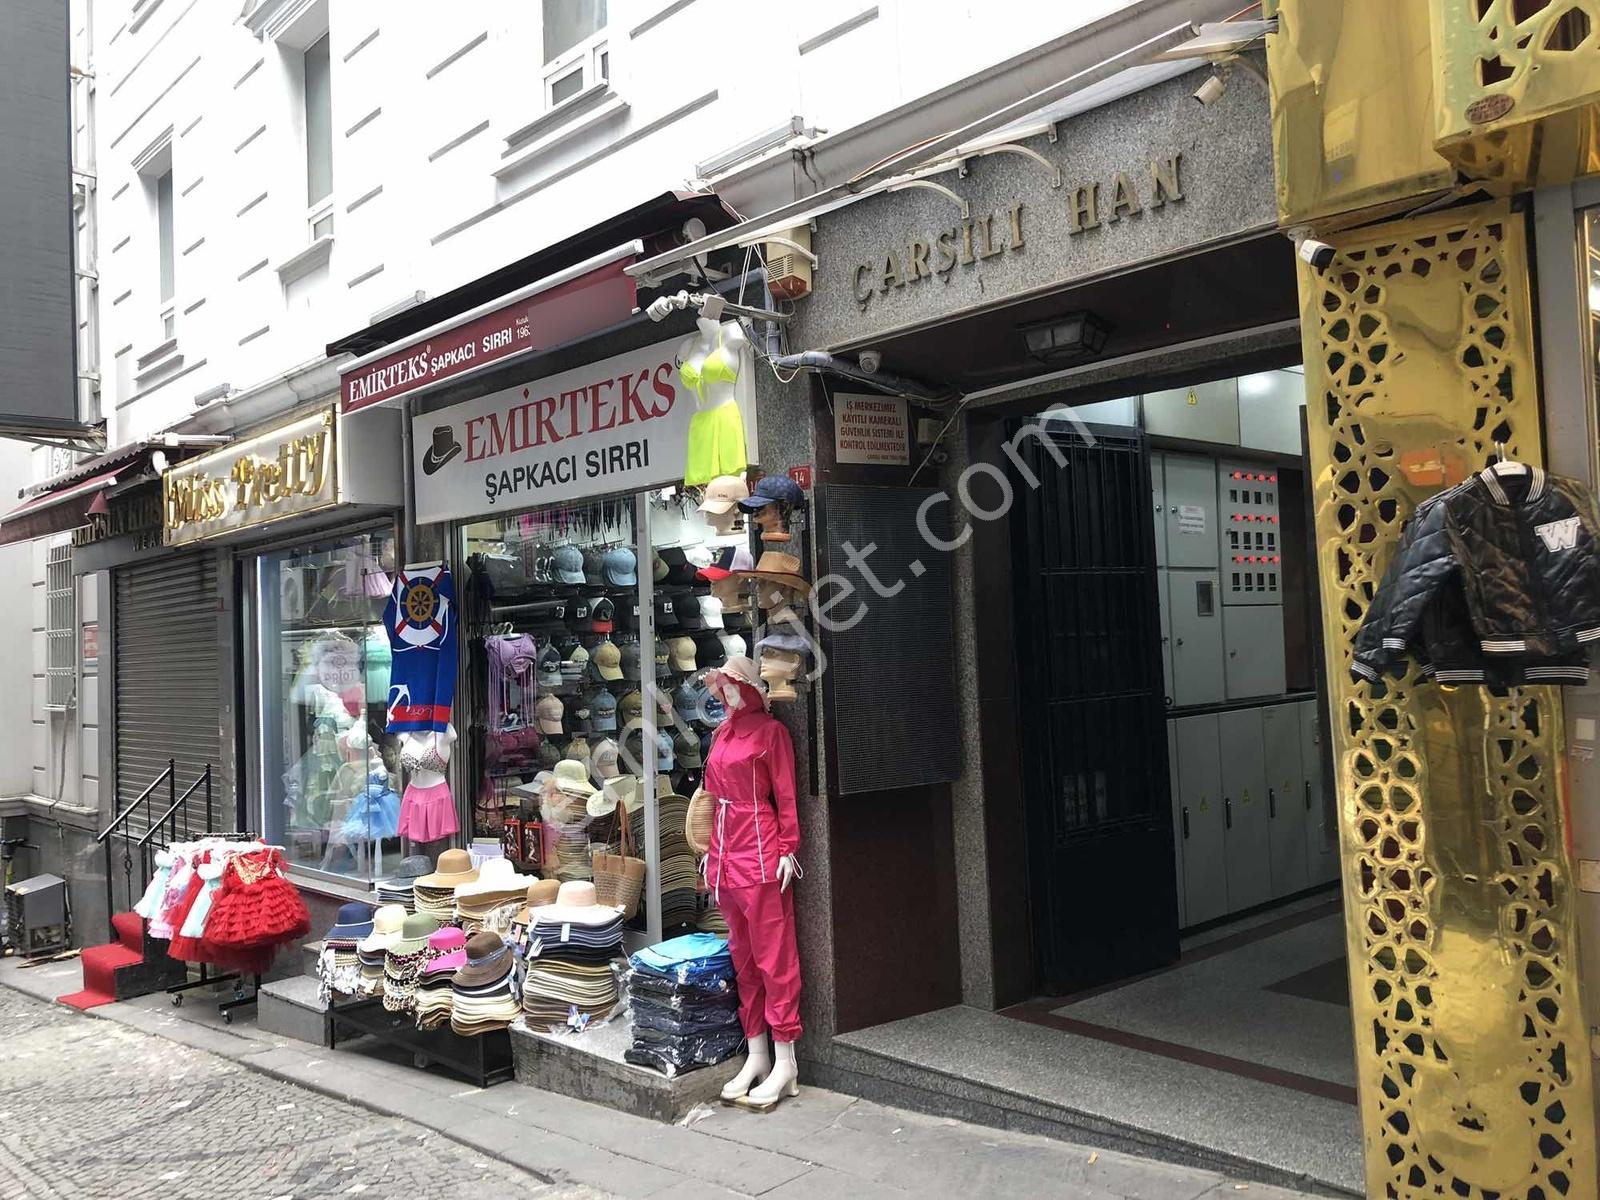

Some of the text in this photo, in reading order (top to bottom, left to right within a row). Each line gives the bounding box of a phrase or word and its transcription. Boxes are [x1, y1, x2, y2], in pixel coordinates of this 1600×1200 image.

[1068, 152, 1183, 236] HAN
[349, 327, 512, 403] EMİRTEKS ŞAPKACI SIRRI
[464, 362, 676, 463] EMİRTEKS
[485, 438, 650, 503] ŞAPKACI SIRRI
[795, 471, 805, 484] 14
[1534, 516, 1581, 552] W
